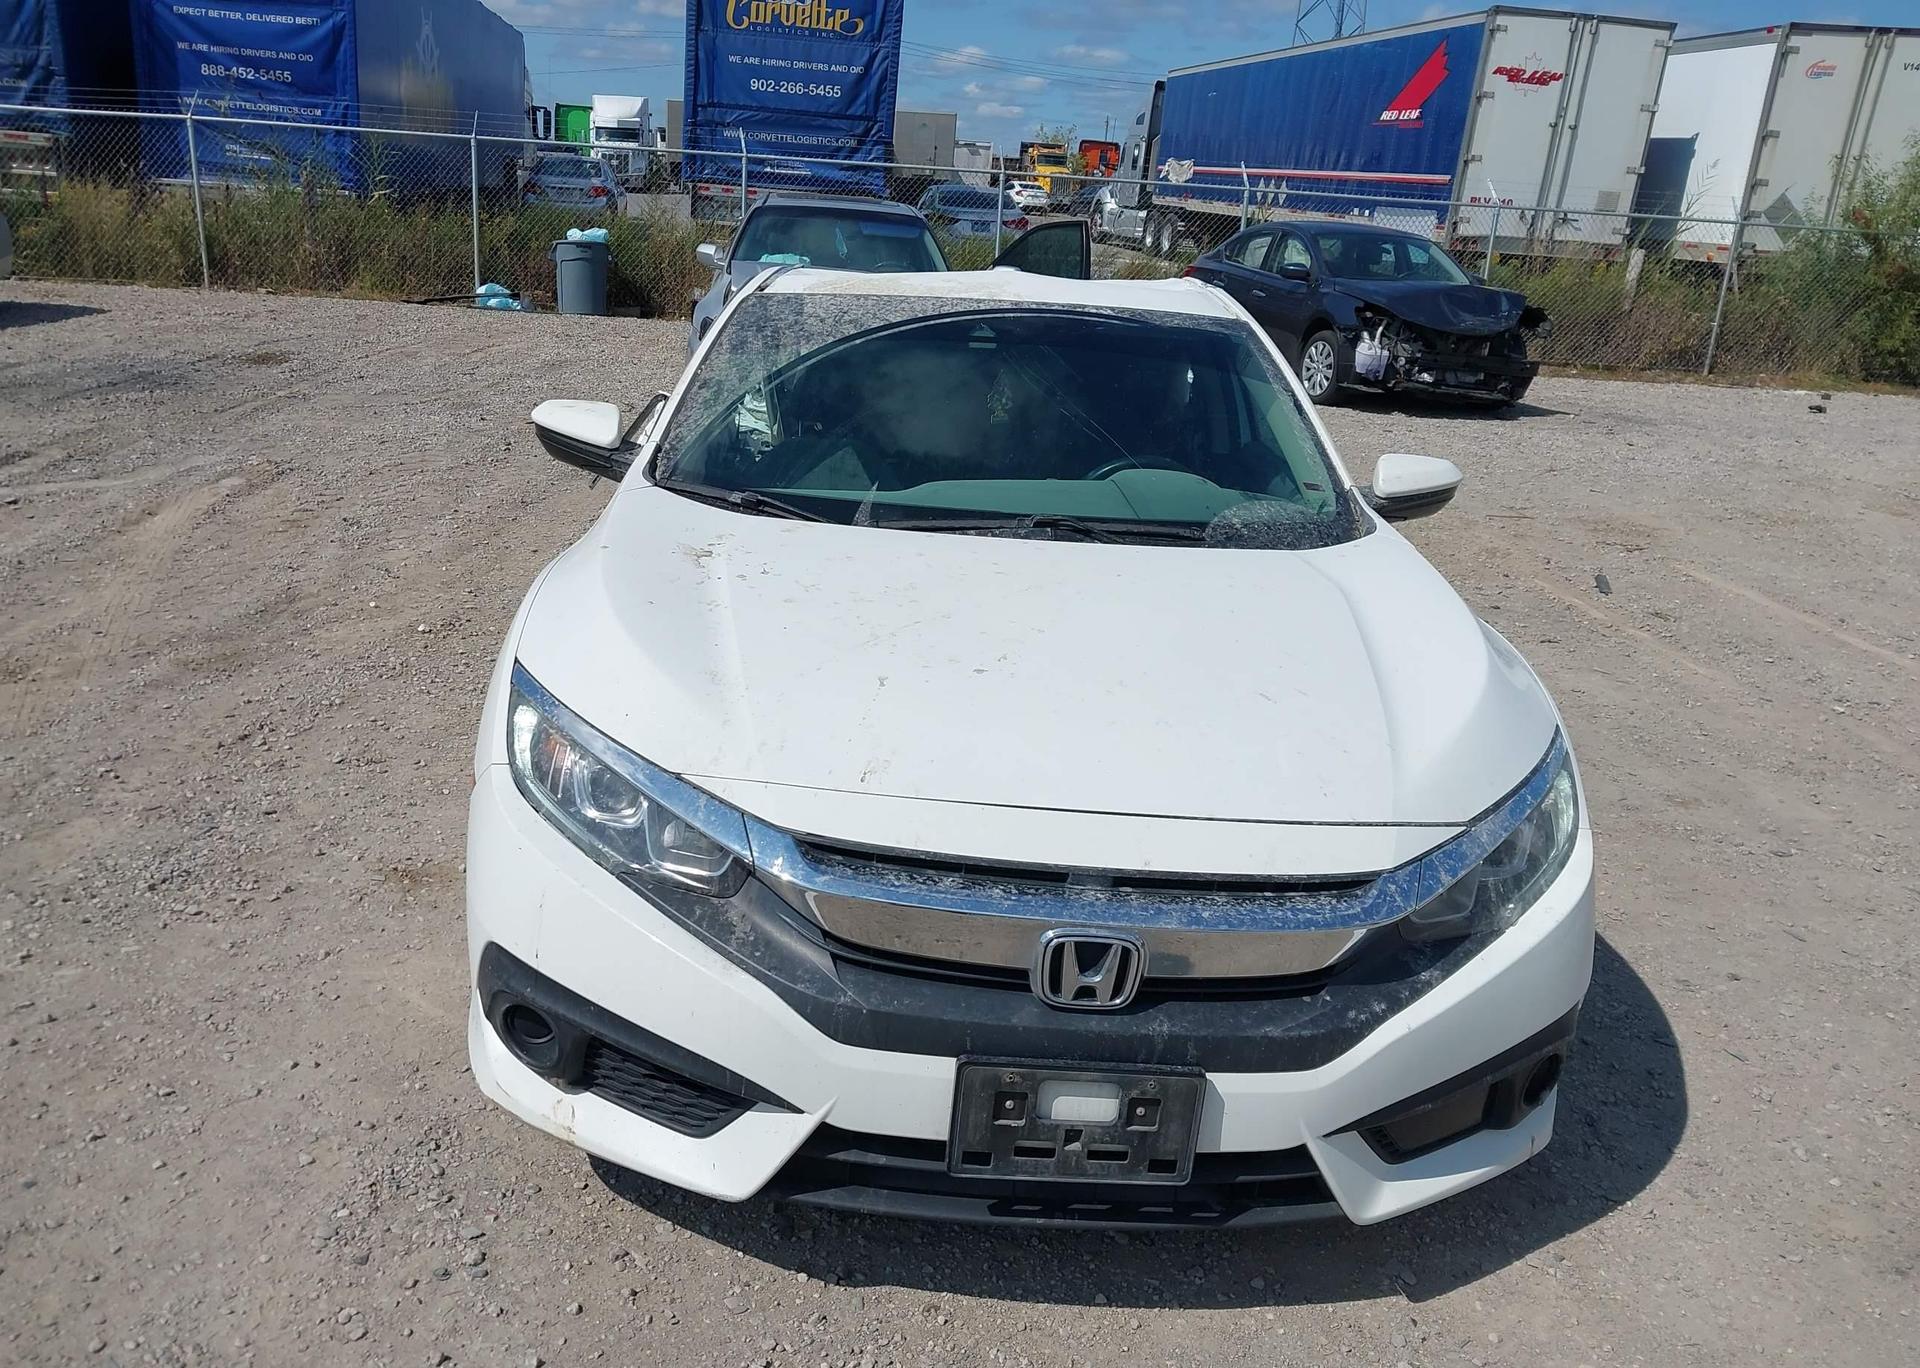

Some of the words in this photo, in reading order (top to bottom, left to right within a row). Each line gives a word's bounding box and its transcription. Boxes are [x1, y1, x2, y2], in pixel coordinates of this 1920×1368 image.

[173, 5, 206, 17] EXPECT
[208, 10, 244, 21] BETTER,
[246, 13, 294, 24] DELIVERED
[296, 17, 321, 26] BEST!
[750, 25, 809, 36] LOGISTICS
[177, 41, 190, 50] WE
[192, 43, 209, 52] ARE
[210, 45, 240, 55] HIRING
[240, 48, 277, 59] DRIVERS
[279, 52, 297, 60] AND
[201, 63, 292, 83] 888-452-5455
[728, 54, 742, 64] WE
[743, 56, 761, 65] ARE
[762, 58, 792, 68] HIRING
[793, 61, 829, 72] DRIVERS
[830, 64, 848, 73] AND
[750, 78, 841, 98] 902-266-5455
[1380, 110, 1399, 120] RED
[1399, 109, 1422, 120] LEAF
